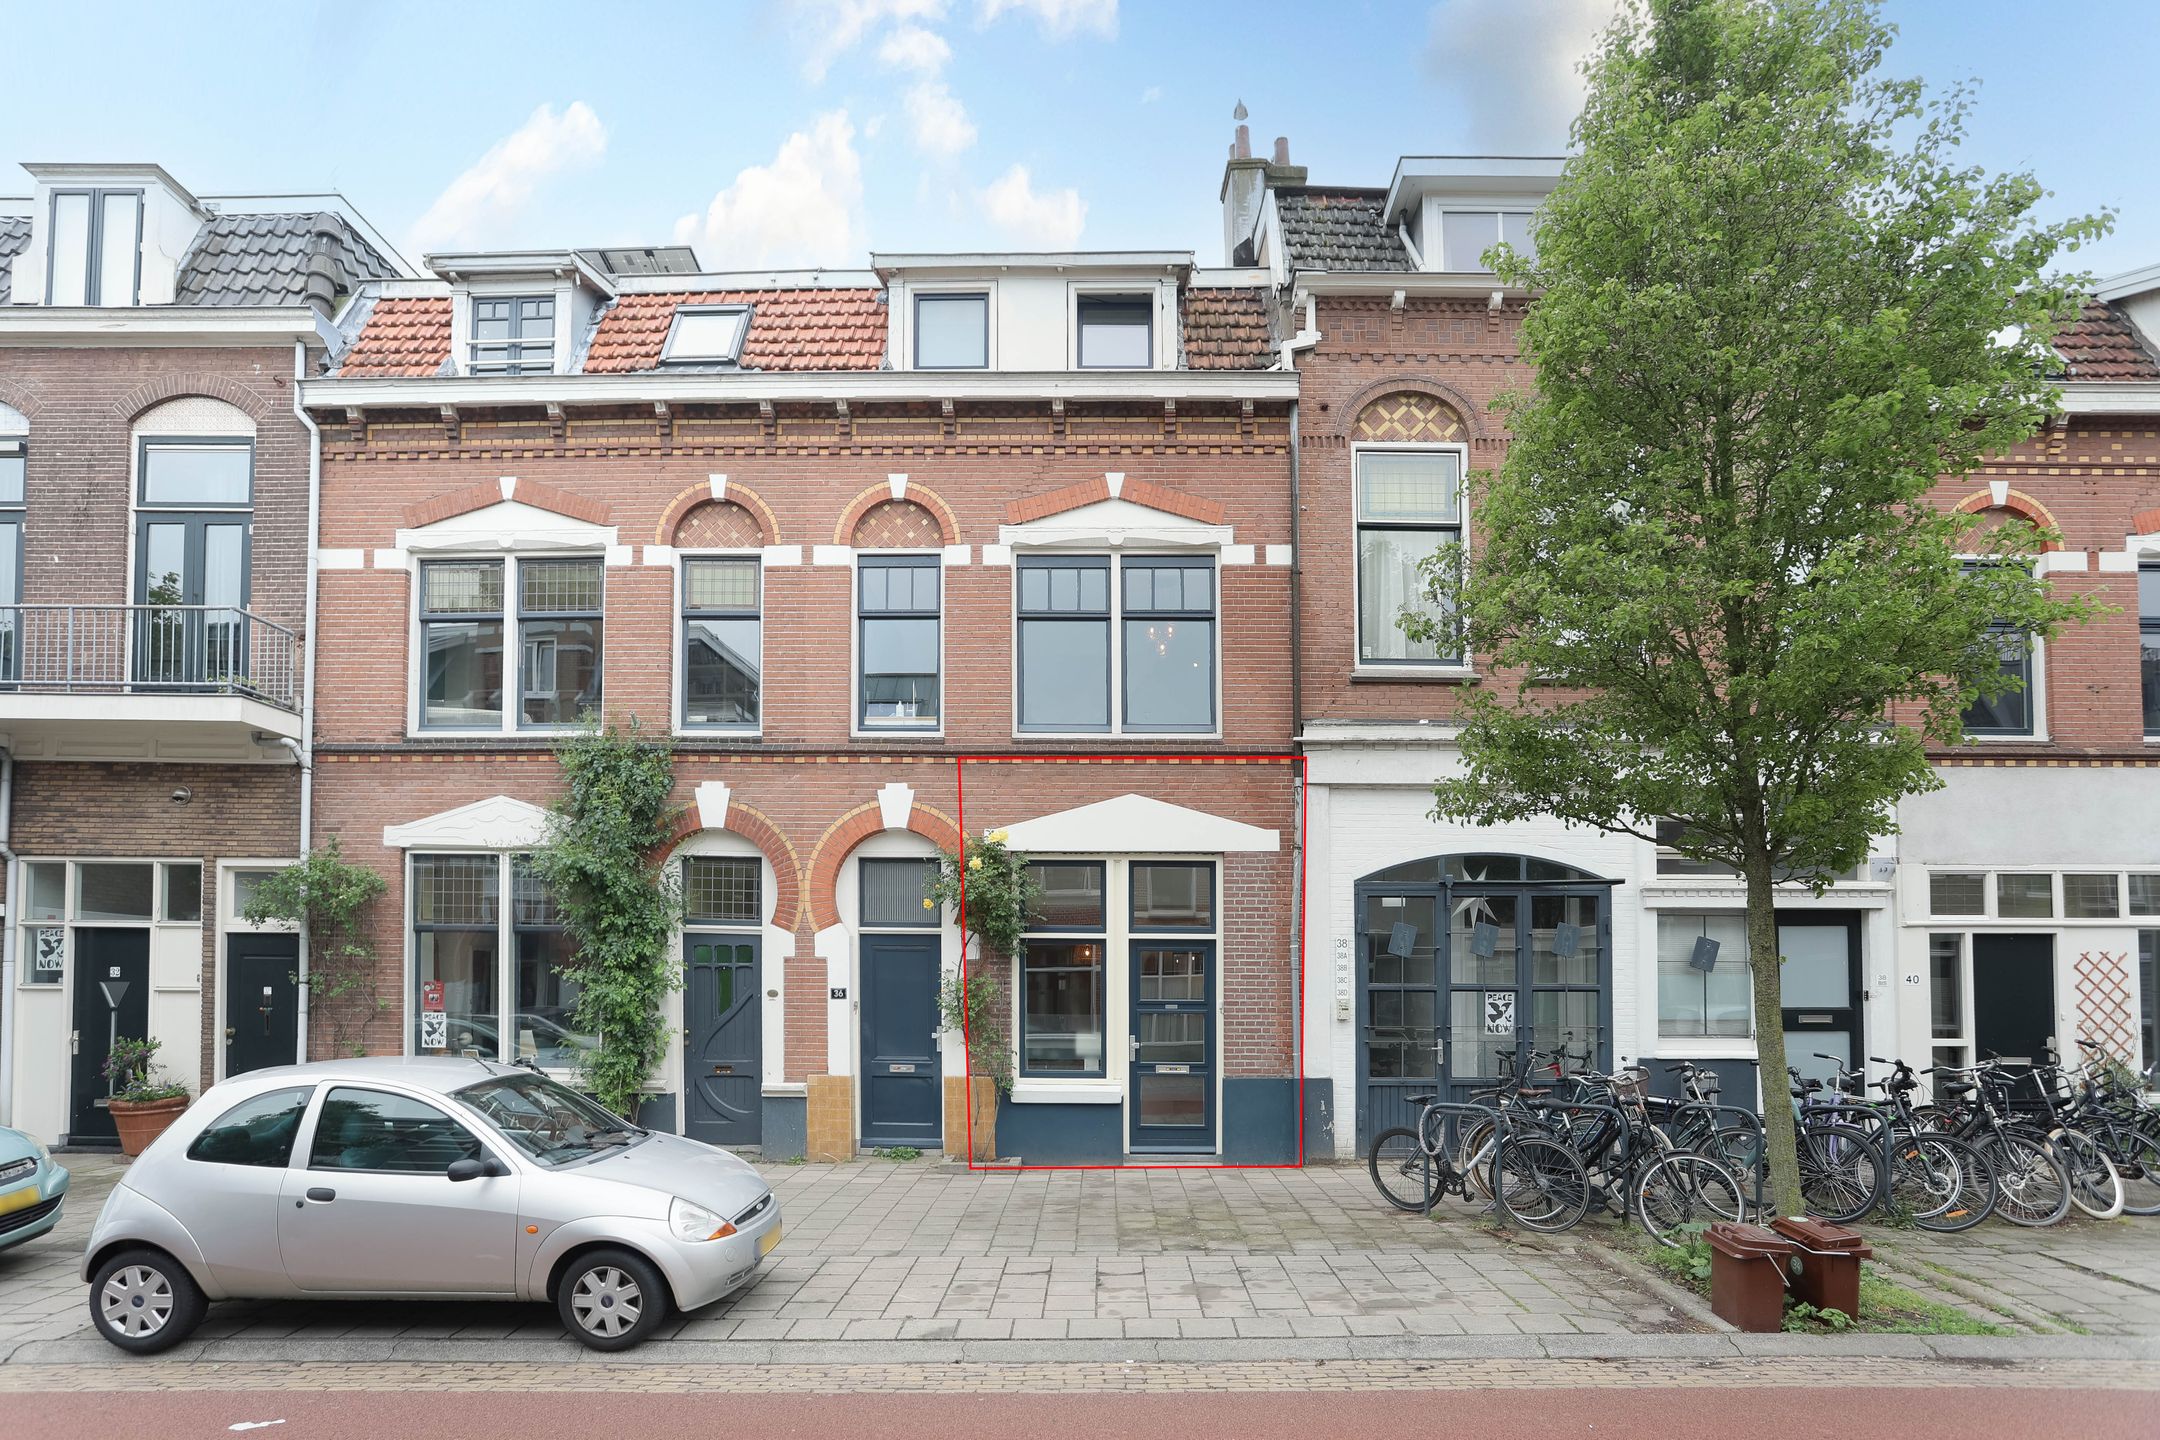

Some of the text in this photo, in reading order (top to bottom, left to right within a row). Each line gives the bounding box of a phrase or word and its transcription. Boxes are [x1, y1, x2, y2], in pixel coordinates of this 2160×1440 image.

[1336, 938, 1348, 948] 38
[39, 960, 63, 968] NOW
[1336, 964, 1348, 972] 38B
[111, 968, 119, 976] 32
[1336, 976, 1348, 984] 38C
[1906, 975, 1920, 984] 40
[833, 989, 844, 998] 36
[1487, 1024, 1512, 1033] NOW
[424, 1038, 445, 1046] NOW
